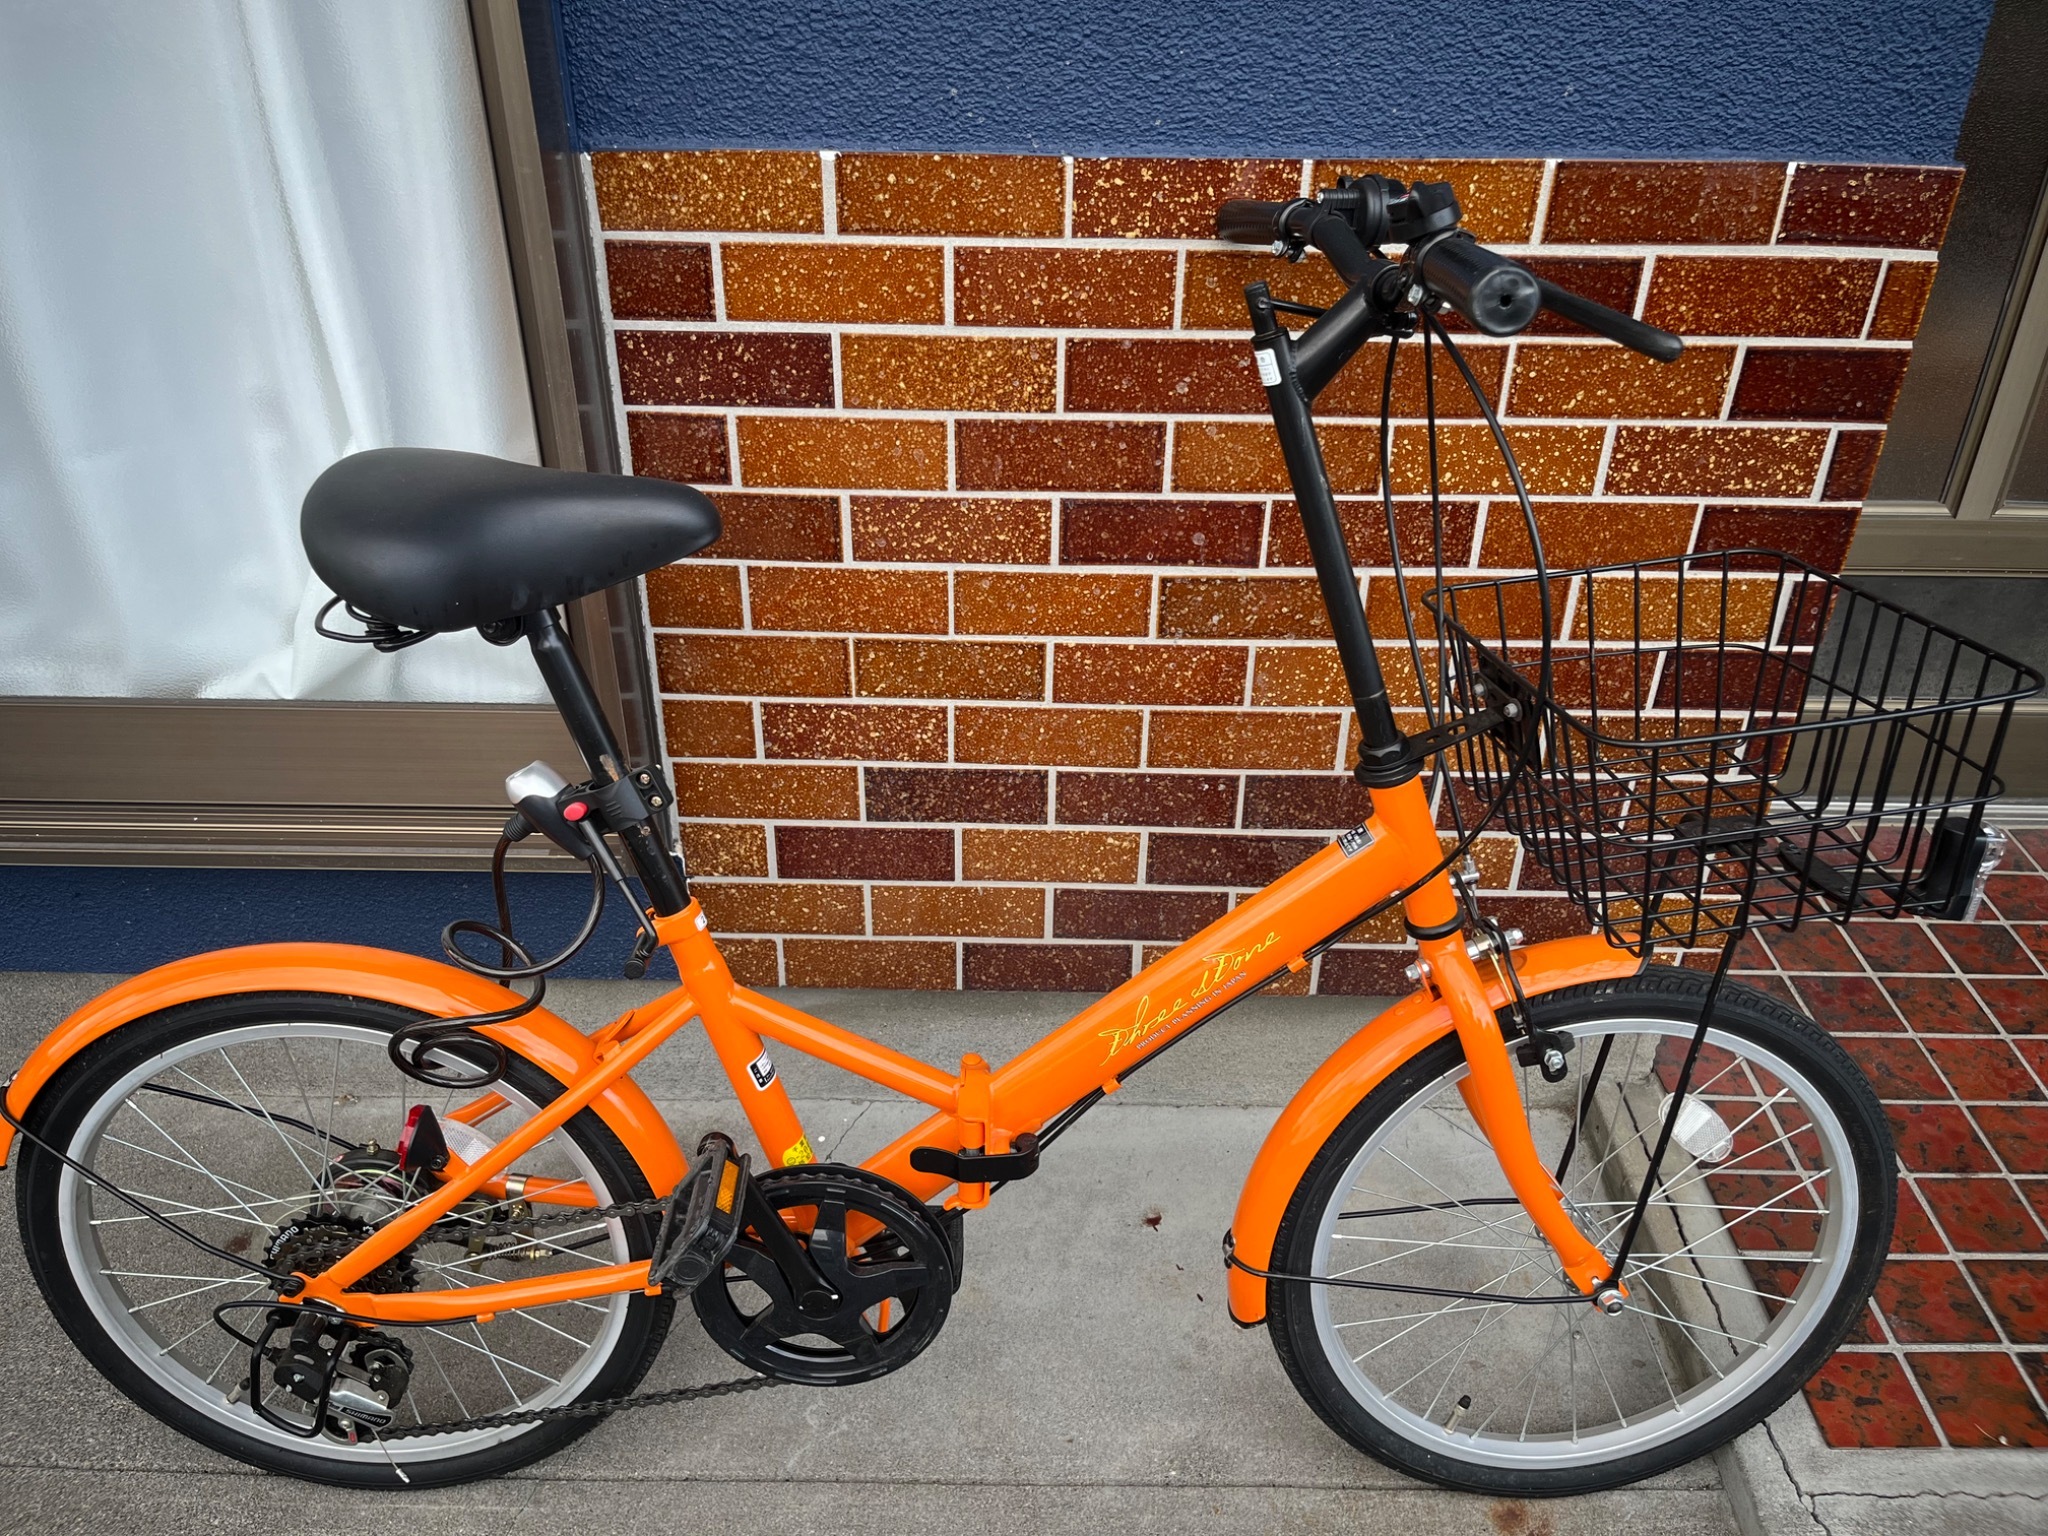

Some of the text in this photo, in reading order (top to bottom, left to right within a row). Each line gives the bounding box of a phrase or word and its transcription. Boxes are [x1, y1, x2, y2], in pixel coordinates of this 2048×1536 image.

[1136, 971, 1247, 1050] PRODUCT PLANNING IN JAPAN
[346, 1409, 387, 1424] SHIMANO
